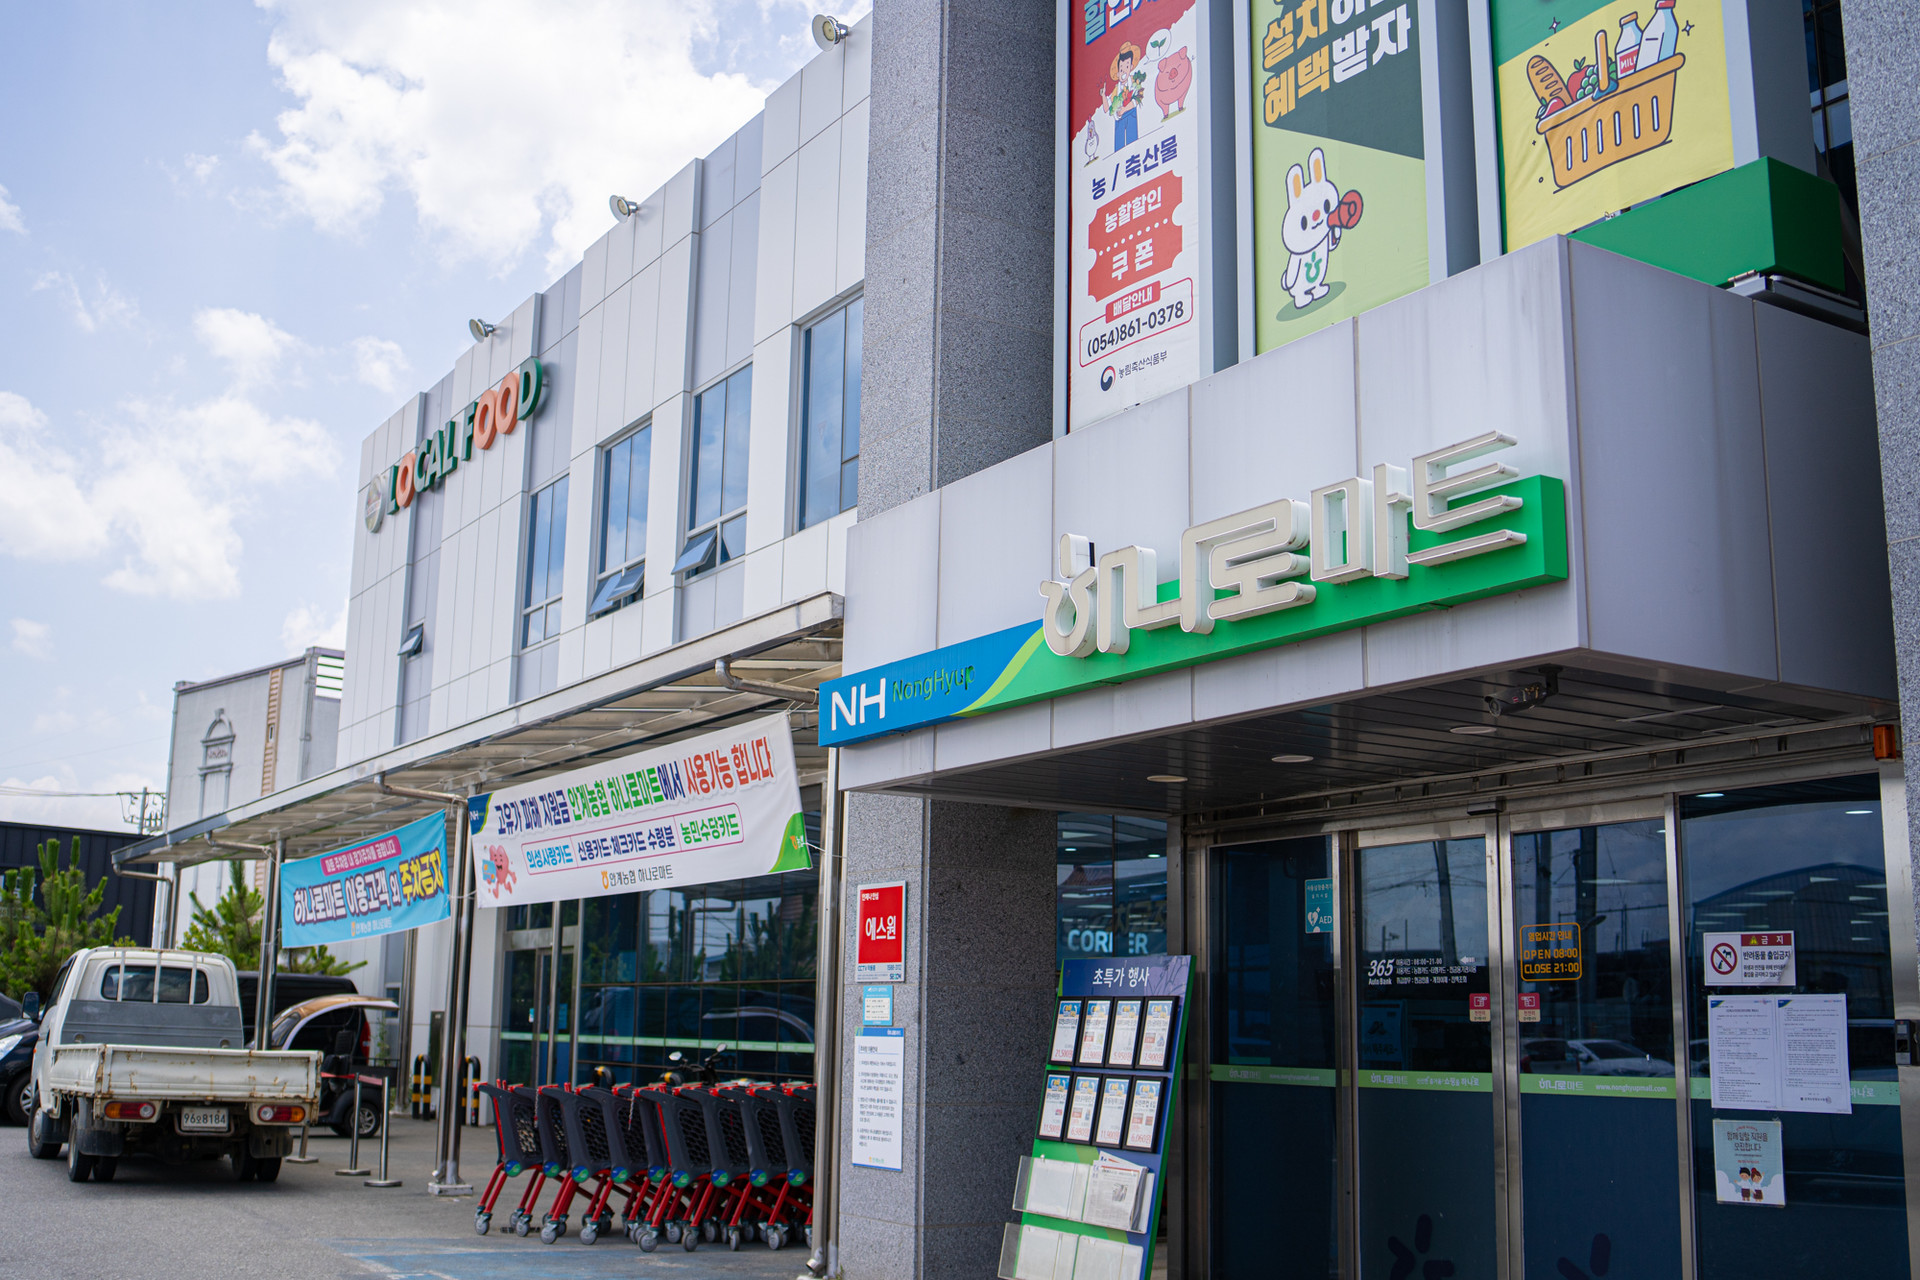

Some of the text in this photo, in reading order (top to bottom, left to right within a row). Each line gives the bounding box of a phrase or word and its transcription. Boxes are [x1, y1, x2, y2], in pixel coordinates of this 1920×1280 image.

[1091, 178, 1106, 201] 농
[1125, 134, 1178, 178] 축산물
[1104, 186, 1162, 234] 농할할인
[1112, 285, 1153, 316] 배달안내
[1087, 300, 1184, 357] (054)861-0378
[1118, 350, 1167, 379] 농림축산식품부
[387, 358, 543, 515] LOCAL FOOD
[1039, 430, 1527, 659] 하나로마트
[831, 665, 976, 731] NH NongHyup
[494, 800, 523, 835] 고유가
[520, 796, 542, 830] 피해
[538, 789, 571, 826] 지원금
[567, 779, 611, 821] 안계농협
[647, 825, 676, 851] 수령분
[680, 813, 740, 844] 농민수당카드
[526, 844, 573, 869] 의성사랑카드
[609, 864, 674, 887] 안계농협 하나로마트
[294, 881, 347, 924] 하나로마트
[345, 868, 391, 915] 이용고객
[865, 915, 896, 940] 에스원
[1319, 915, 1333, 924] AED
[1528, 930, 1572, 941] 영업시간 안내
[1524, 948, 1578, 960] OPEN 08:00
[1743, 950, 1790, 960] 반려동물 출입금지
[1092, 966, 1150, 988] 초특가 행사
[1368, 959, 1395, 977] 365
[1524, 962, 1579, 974] CLOSE 21:00
[1539, 1077, 1585, 1091] 하나로마트
